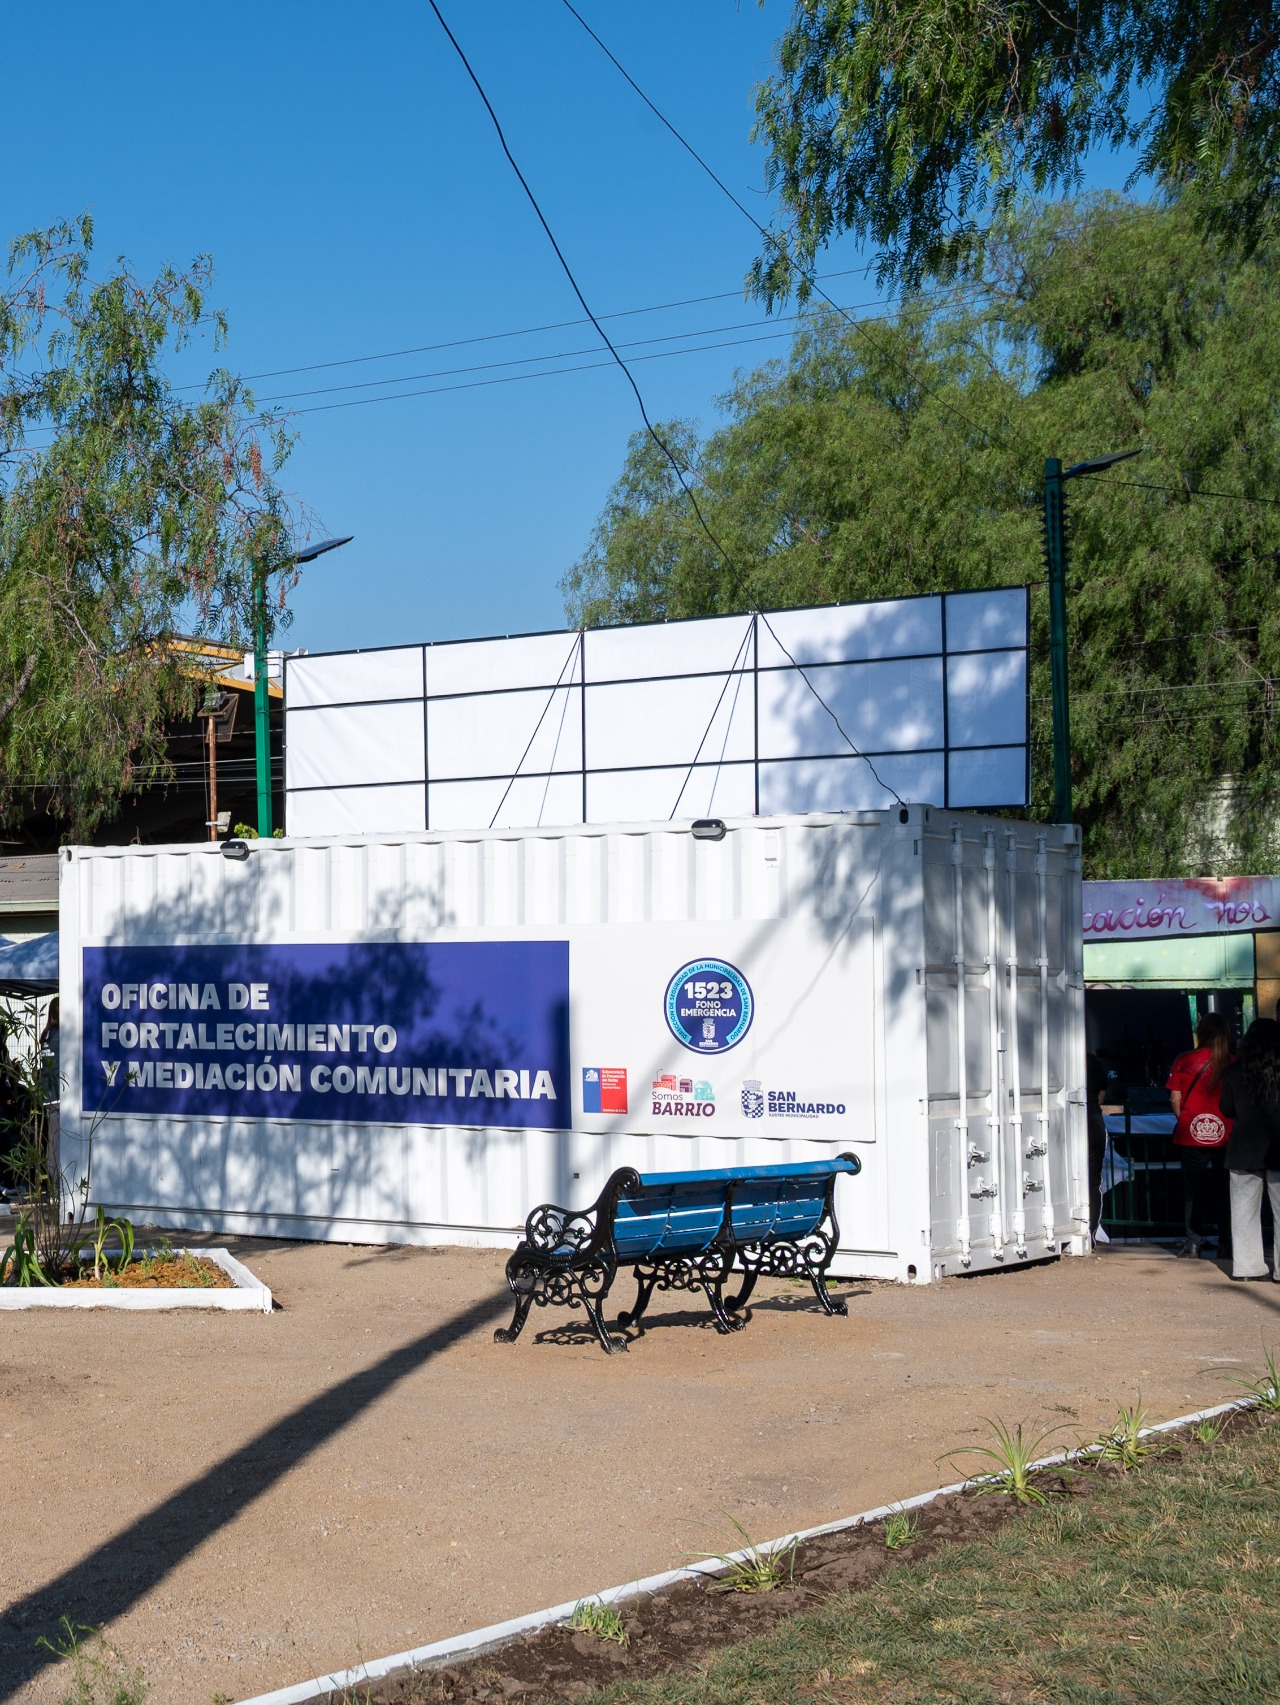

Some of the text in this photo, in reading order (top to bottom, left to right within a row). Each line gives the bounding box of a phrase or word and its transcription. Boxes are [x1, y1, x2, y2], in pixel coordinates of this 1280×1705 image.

[704, 964, 743, 988] MUNICIPALIDAD
[670, 972, 688, 1001] SEGURIDAD
[684, 981, 733, 999] 1523
[741, 988, 747, 996] DE
[101, 983, 270, 1010] OFICINA DE
[695, 1000, 722, 1009] FONO
[680, 1008, 737, 1017] EMERGENCIA
[730, 1010, 748, 1040] BERNARDO
[101, 1022, 398, 1053] FORTALECIMIENTO
[101, 1055, 558, 1100] Y MEDIACIÓN COMUNITARIA
[651, 1091, 683, 1101] Somos
[767, 1091, 796, 1102] SAN
[652, 1102, 716, 1117] BARRIO
[768, 1102, 846, 1114] BERNARDO
